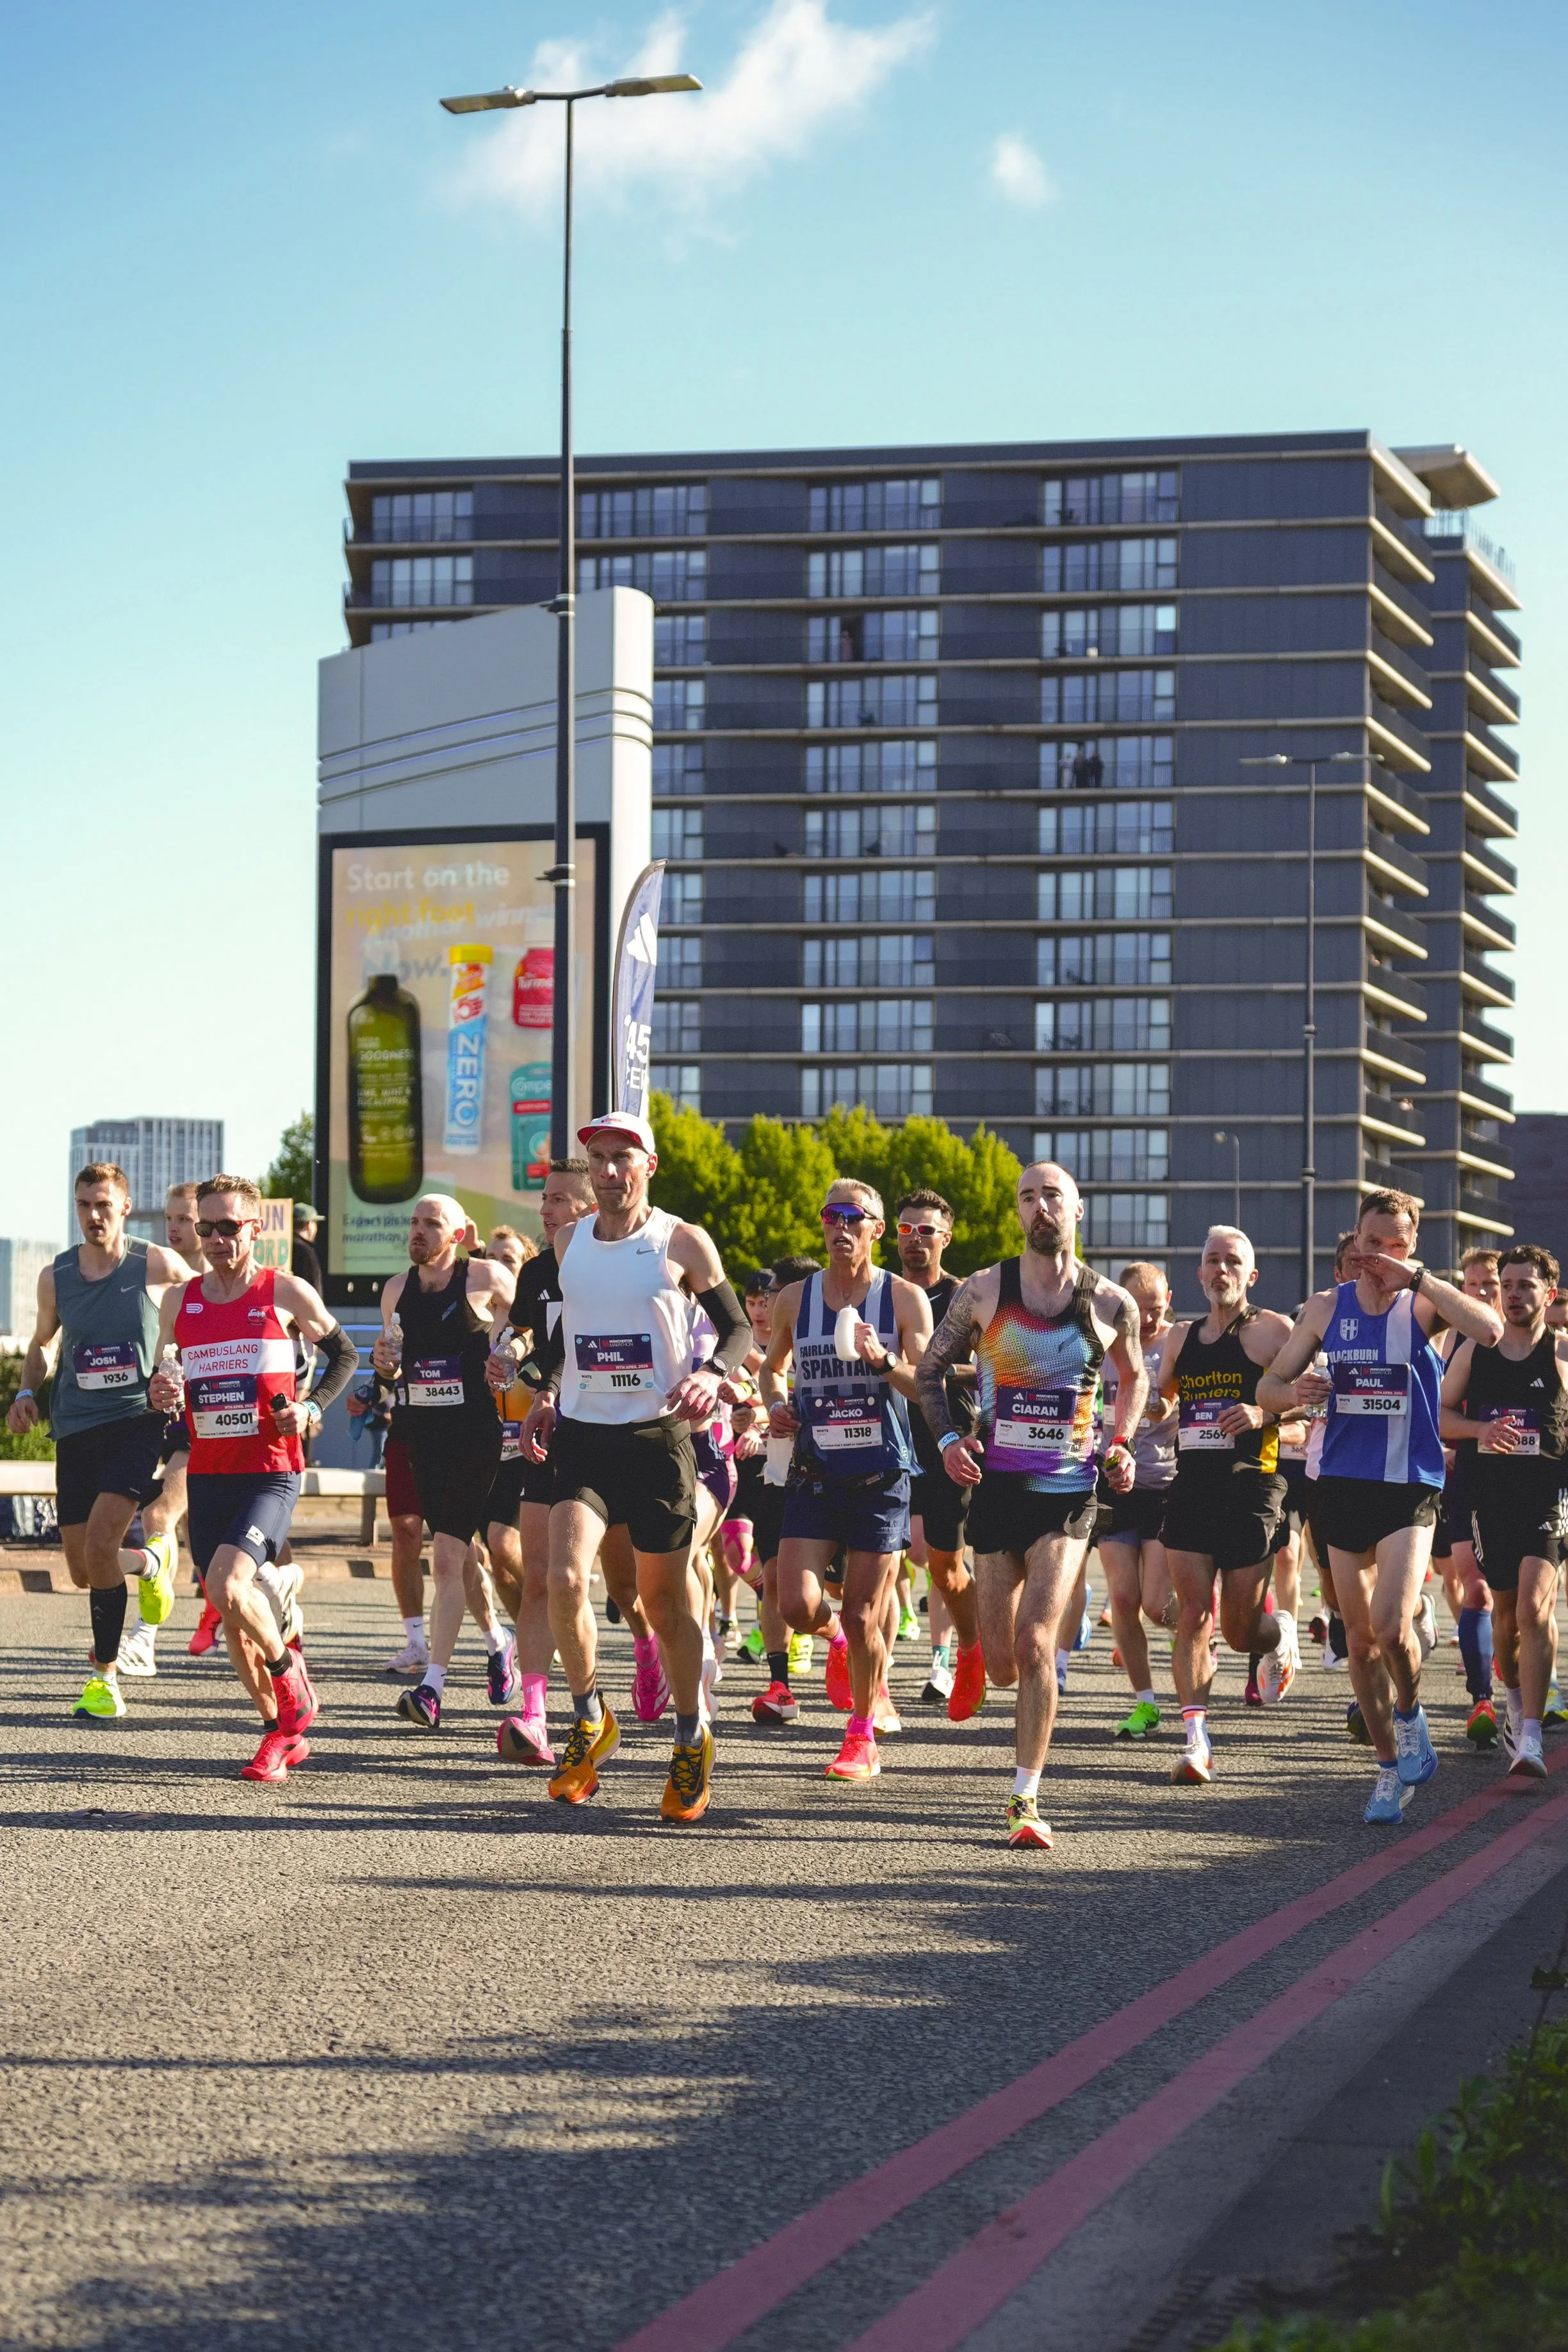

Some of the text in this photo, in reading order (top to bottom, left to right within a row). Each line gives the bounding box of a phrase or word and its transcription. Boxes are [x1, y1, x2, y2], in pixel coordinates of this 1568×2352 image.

[347, 860, 509, 890] Start on the
[420, 898, 475, 924] foot
[454, 1032, 480, 1126] ZERO
[259, 1204, 284, 1232] UN
[253, 1239, 288, 1266] ORD
[188, 1344, 259, 1360] CAMBUSLANG
[597, 1352, 624, 1362] PHIL
[1328, 1349, 1378, 1363] BLACKBURN
[90, 1356, 116, 1366] JOSH
[199, 1359, 249, 1373] HARRIERS
[801, 1357, 881, 1380] SPARTAN
[102, 1372, 128, 1384] 1936
[610, 1373, 641, 1387] 11116
[1180, 1371, 1243, 1389] Chorlton
[1355, 1378, 1384, 1387] PAUL
[198, 1391, 245, 1404] STEPHEN
[425, 1386, 460, 1396] 38443
[1012, 1403, 1058, 1416] CIARAN
[1362, 1399, 1400, 1410] 31504
[215, 1412, 254, 1426] 40501
[829, 1409, 863, 1418] JACKO
[1195, 1412, 1213, 1420] BEN
[1507, 1418, 1524, 1426] ON
[844, 1426, 872, 1438] 11318
[1028, 1426, 1065, 1440] 3646
